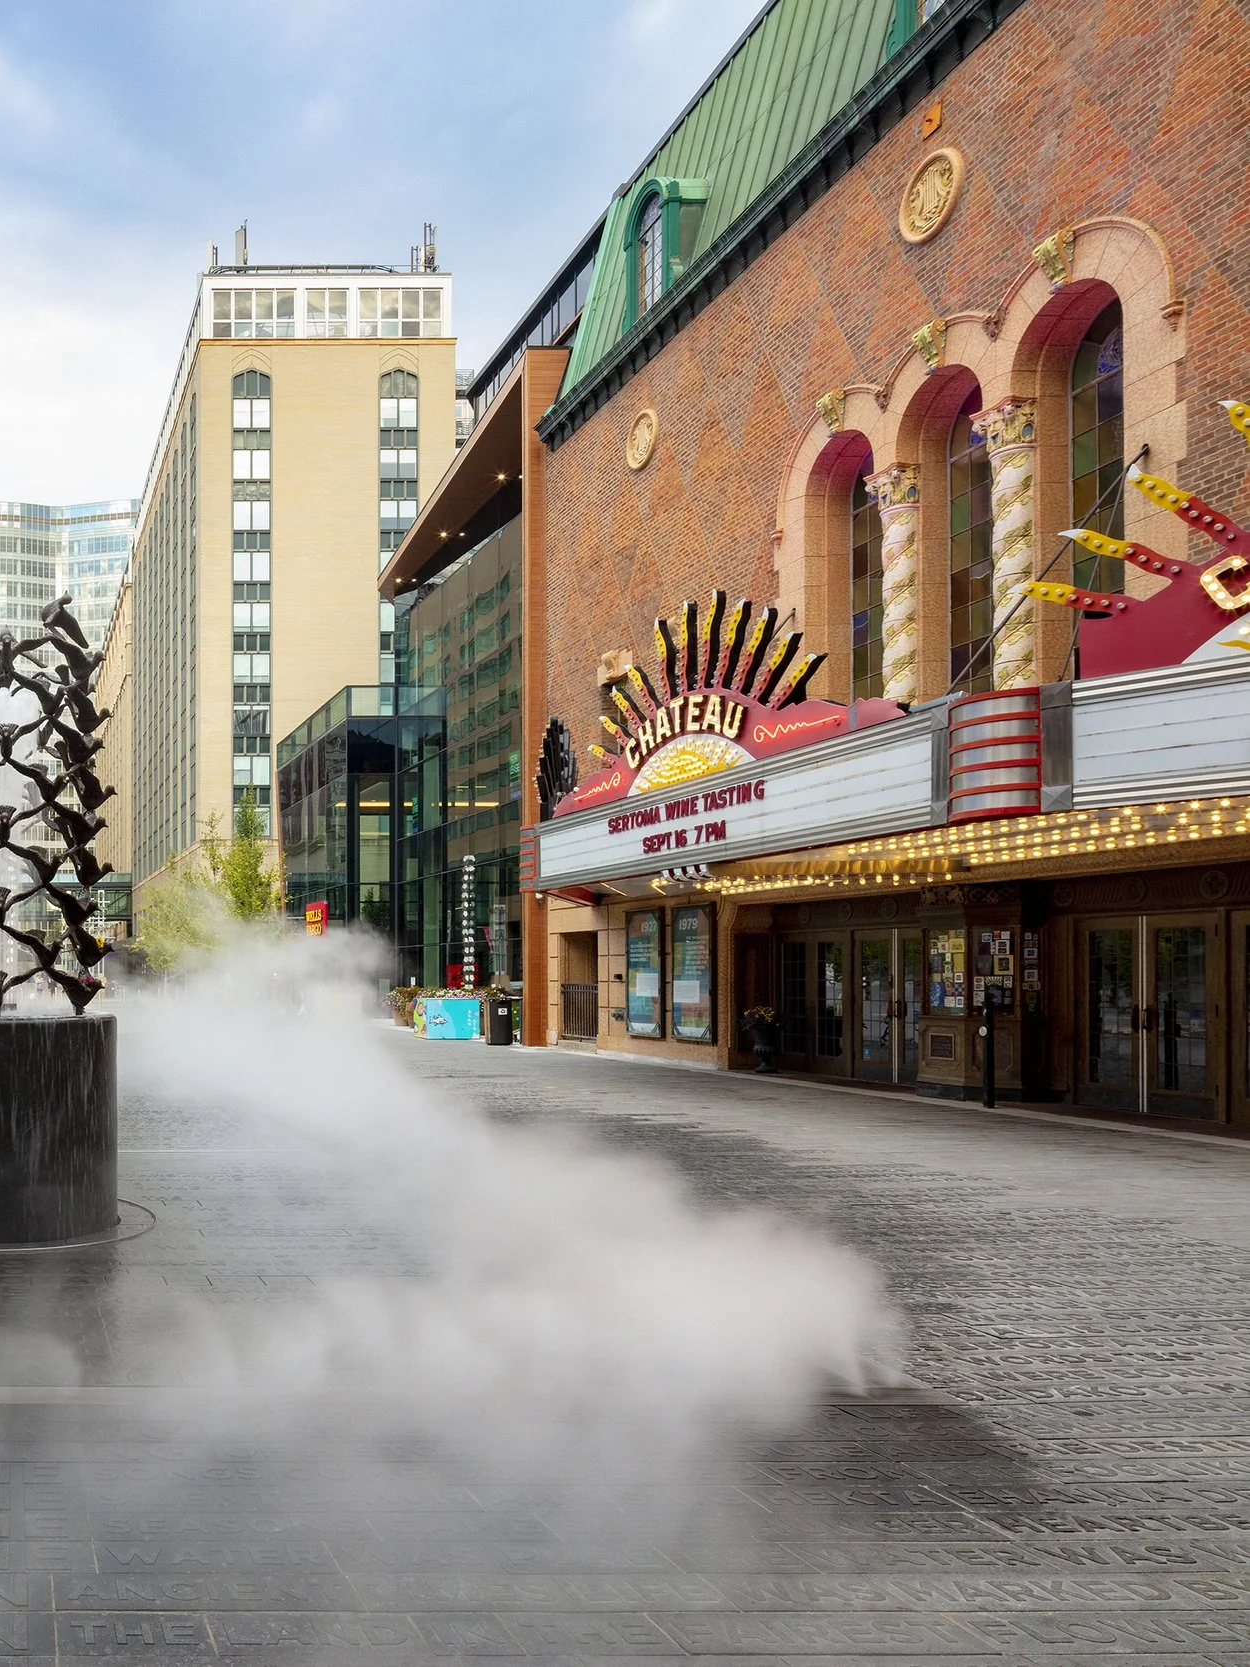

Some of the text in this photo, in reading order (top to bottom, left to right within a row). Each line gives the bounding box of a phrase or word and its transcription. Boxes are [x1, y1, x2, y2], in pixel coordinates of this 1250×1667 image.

[625, 694, 746, 769] CHATEAU
[607, 807, 662, 834] SERTOMA
[665, 795, 699, 819] WINE
[642, 820, 727, 854] SEPT 16 7 PM
[306, 909, 322, 922] WELLS
[678, 917, 698, 931] 1979
[955, 1313, 1101, 1321] WORLD
[1102, 1323, 1219, 1332] CALM
[941, 1339, 1109, 1350] BEFORE
[952, 1353, 1120, 1366] WORDS
[969, 1367, 1236, 1381] WERE BORN
[943, 1383, 1210, 1401] DE DAKOTA
[1062, 1403, 1172, 1415] THE
[765, 1466, 932, 1480] FROM
[105, 1545, 329, 1566] WATER
[798, 1547, 1042, 1566] WATER
[1029, 1545, 1208, 1565] WAS
[66, 1581, 346, 1602] ANCIENT
[721, 1580, 892, 1602] WAS
[887, 1580, 1186, 1602] MARKED
[70, 1624, 201, 1645] THE
[221, 1622, 413, 1645] LAND
[517, 1622, 665, 1645] THE
[670, 1621, 973, 1645] FAIREST
